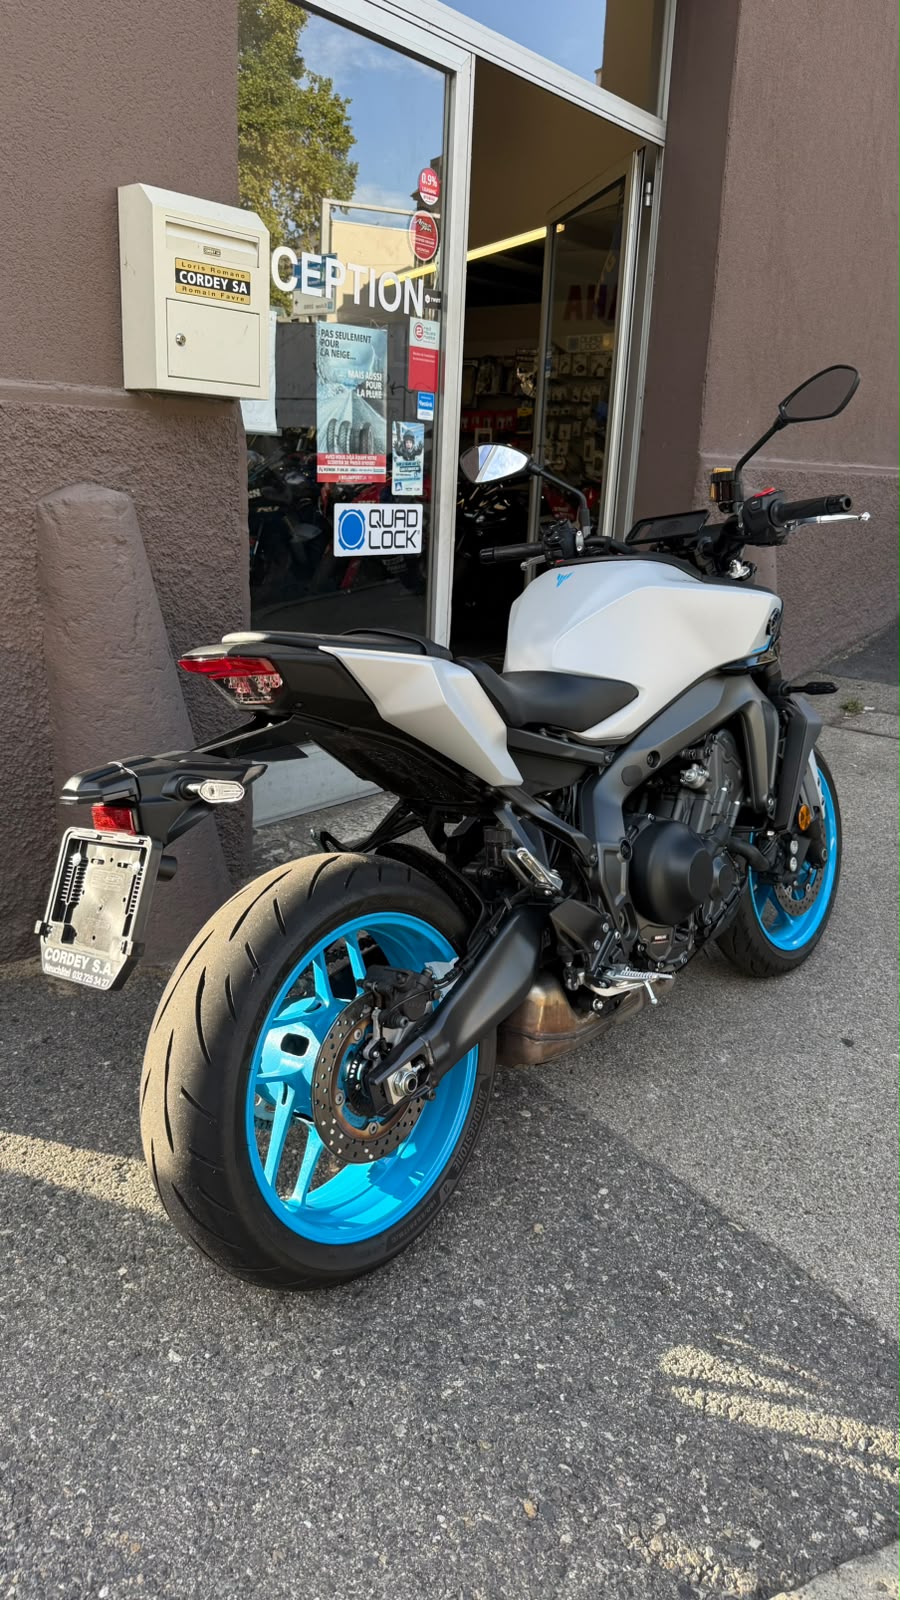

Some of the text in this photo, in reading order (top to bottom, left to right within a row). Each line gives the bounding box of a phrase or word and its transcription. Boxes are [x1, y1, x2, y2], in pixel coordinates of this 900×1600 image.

[421, 172, 438, 188] 0.9%
[181, 261, 245, 279] Loris Romano
[179, 271, 248, 294] CORDEY SA
[182, 286, 245, 302] Romain Favre
[320, 329, 372, 344] PAS SEULEMENT
[320, 339, 340, 349] POUR
[348, 370, 382, 381] MAIS AUSSI
[357, 388, 382, 399] LA PLUIE
[366, 381, 382, 390] POUR
[369, 509, 418, 528] QUAD
[369, 530, 417, 549] LOCK
[44, 947, 114, 977] CORDEY S.A.
[72, 970, 83, 980] 032
[83, 973, 94, 983] 725
[94, 976, 102, 986] 34
[453, 1089, 487, 1173] BRIDGESTONE
